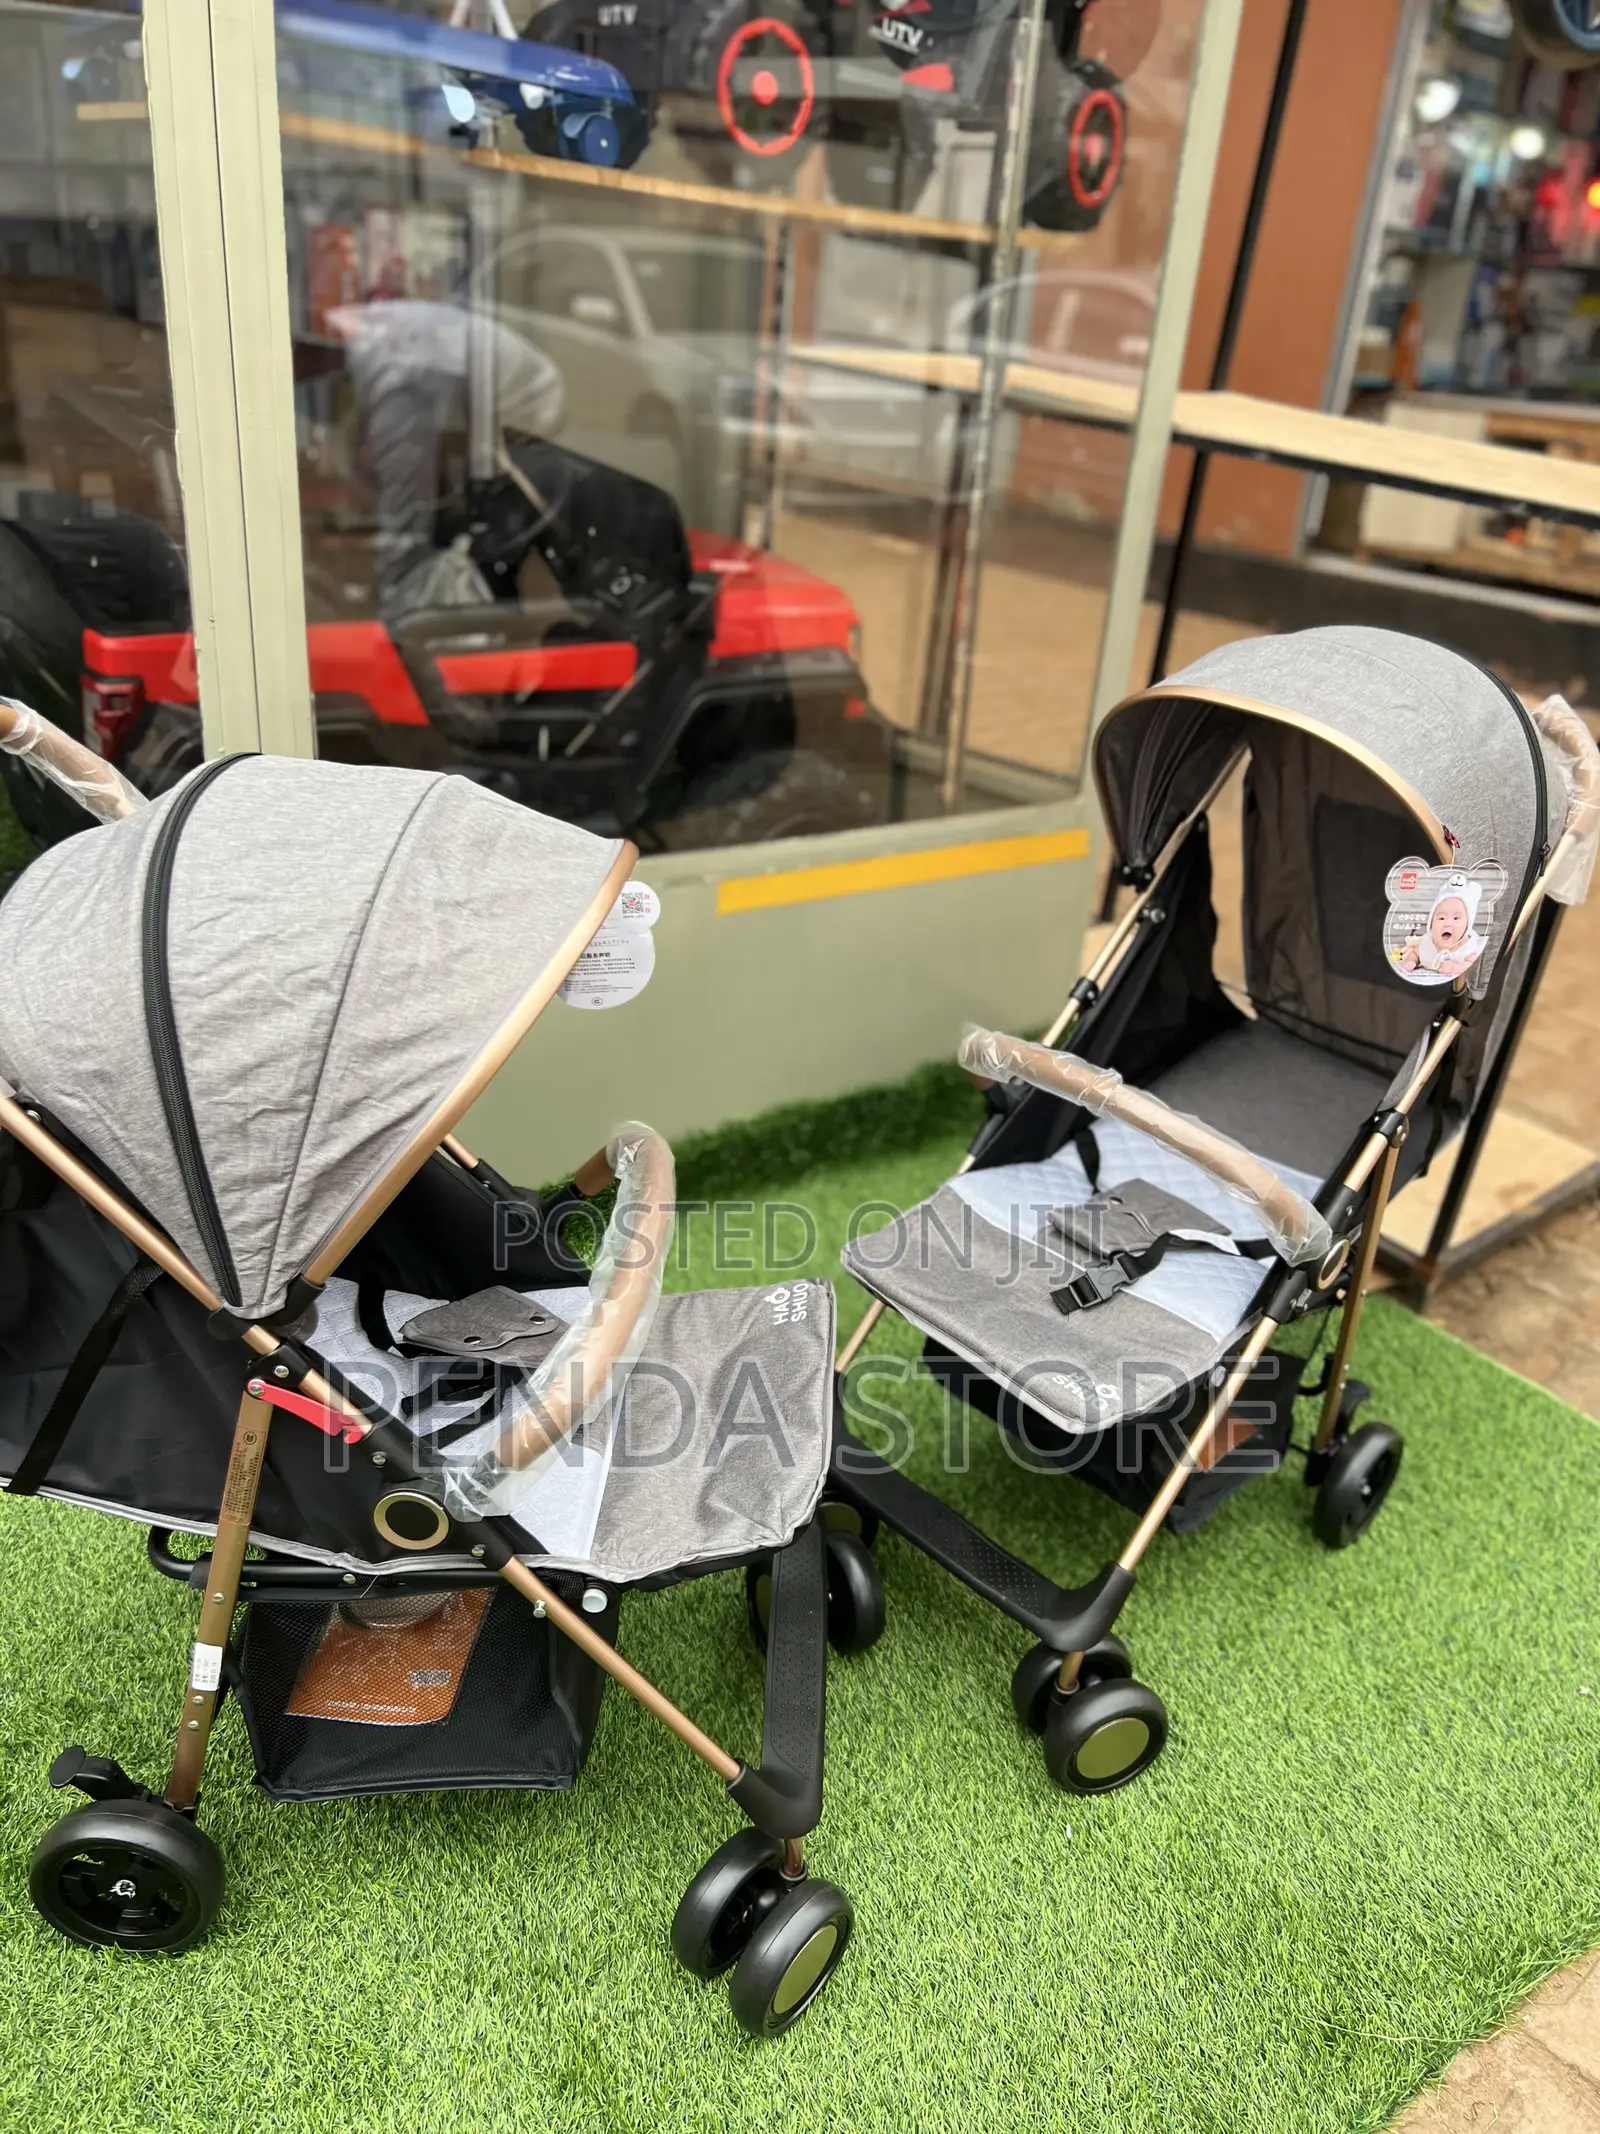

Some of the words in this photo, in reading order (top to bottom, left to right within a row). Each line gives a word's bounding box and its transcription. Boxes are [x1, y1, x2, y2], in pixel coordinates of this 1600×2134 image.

[598, 4, 637, 26] UTV
[881, 17, 924, 48] UTV
[764, 1287, 791, 1326] HAO
[791, 1283, 809, 1322] SHUO
